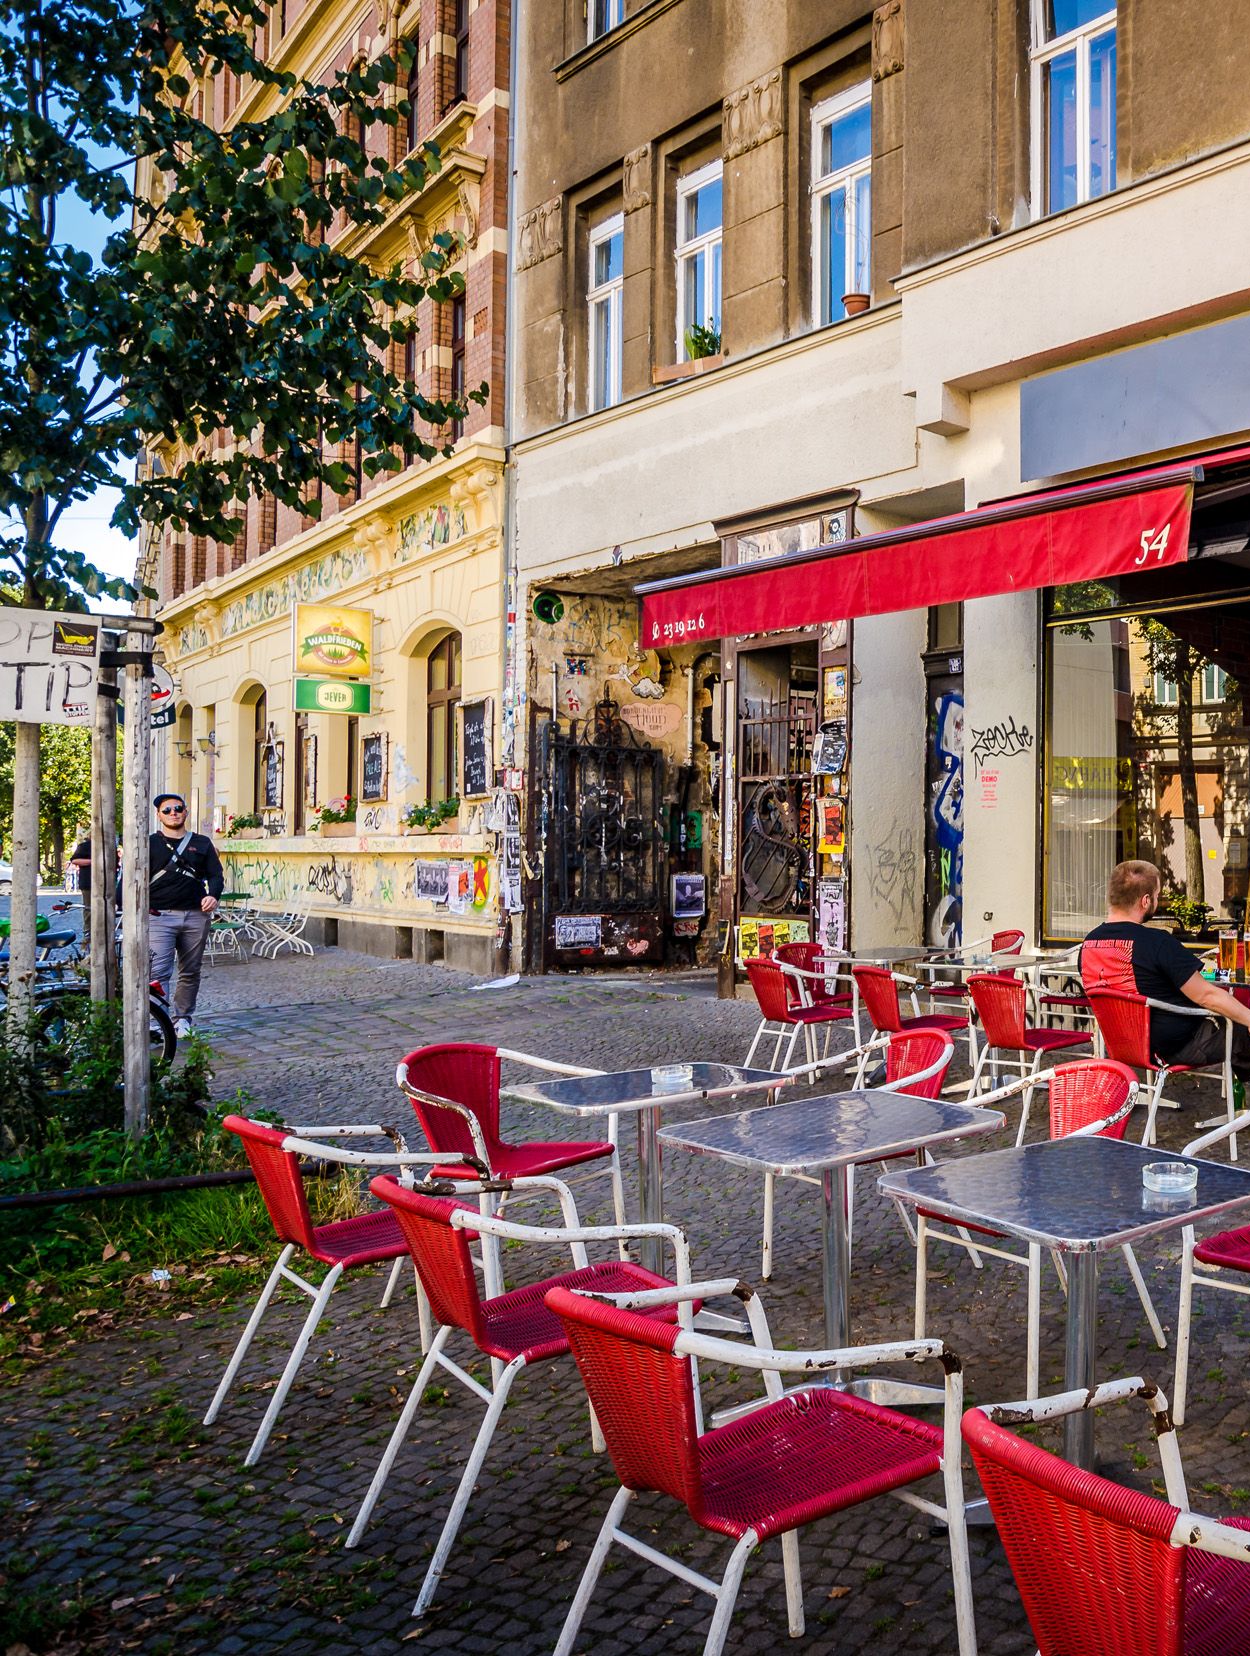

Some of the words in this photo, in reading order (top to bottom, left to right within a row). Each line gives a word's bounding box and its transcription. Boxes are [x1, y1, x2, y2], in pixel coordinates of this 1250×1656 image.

[1135, 522, 1169, 565] 54
[663, 623, 674, 639] 23
[674, 620, 685, 637] 19
[686, 618, 697, 631] 12
[698, 612, 705, 630] 6
[307, 635, 362, 651] WALDFRIEDEN
[324, 692, 347, 703] JEVER
[981, 775, 998, 783] DEMO
